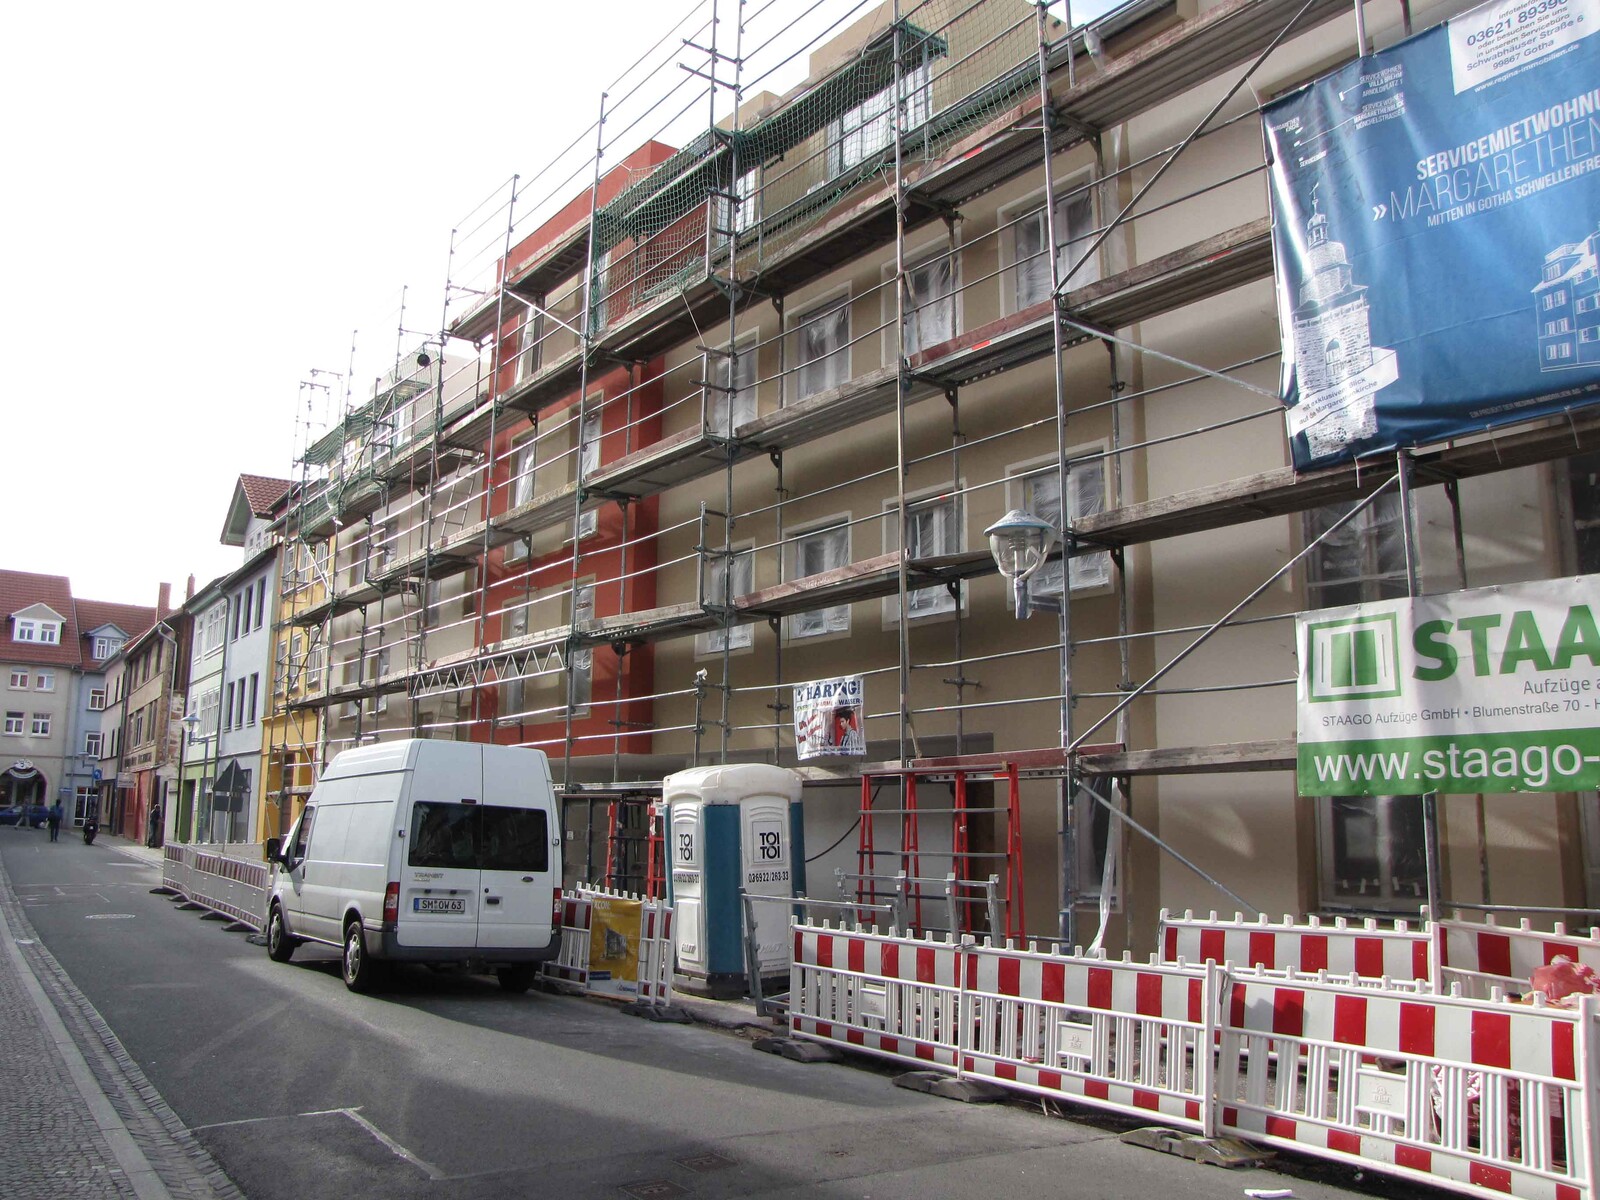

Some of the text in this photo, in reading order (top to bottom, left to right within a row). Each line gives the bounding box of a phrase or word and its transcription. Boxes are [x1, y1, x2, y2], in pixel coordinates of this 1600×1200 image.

[1466, 18, 1512, 47] 03621
[1466, 14, 1584, 71] Schwabhäuser Straße 6
[1477, 6, 1568, 50] oder besuchen Sie uns
[1485, 37, 1519, 55] unserem
[1520, 13, 1570, 39] Servicebüro
[1474, 43, 1580, 93] www.regina-immobilien.de
[1492, 39, 1555, 70] 99867 Gotha
[1427, 155, 1600, 227] MITTEN IN GOTHA SCHWELLENFRE
[1316, 380, 1378, 414] Margaretnkirche
[1412, 604, 1600, 681] STAA
[1523, 676, 1591, 695] Aufzüge
[1322, 714, 1372, 727] STAAGO
[1375, 709, 1417, 725] Aufzüge
[1421, 707, 1460, 721] GmbH
[1473, 700, 1559, 718] Blumenstraße
[1562, 699, 1580, 712] 70
[680, 834, 693, 847] TOI
[760, 832, 780, 845] TOI
[760, 846, 780, 859] TOI
[680, 847, 693, 861] TOI
[422, 900, 462, 910] SM OW 63
